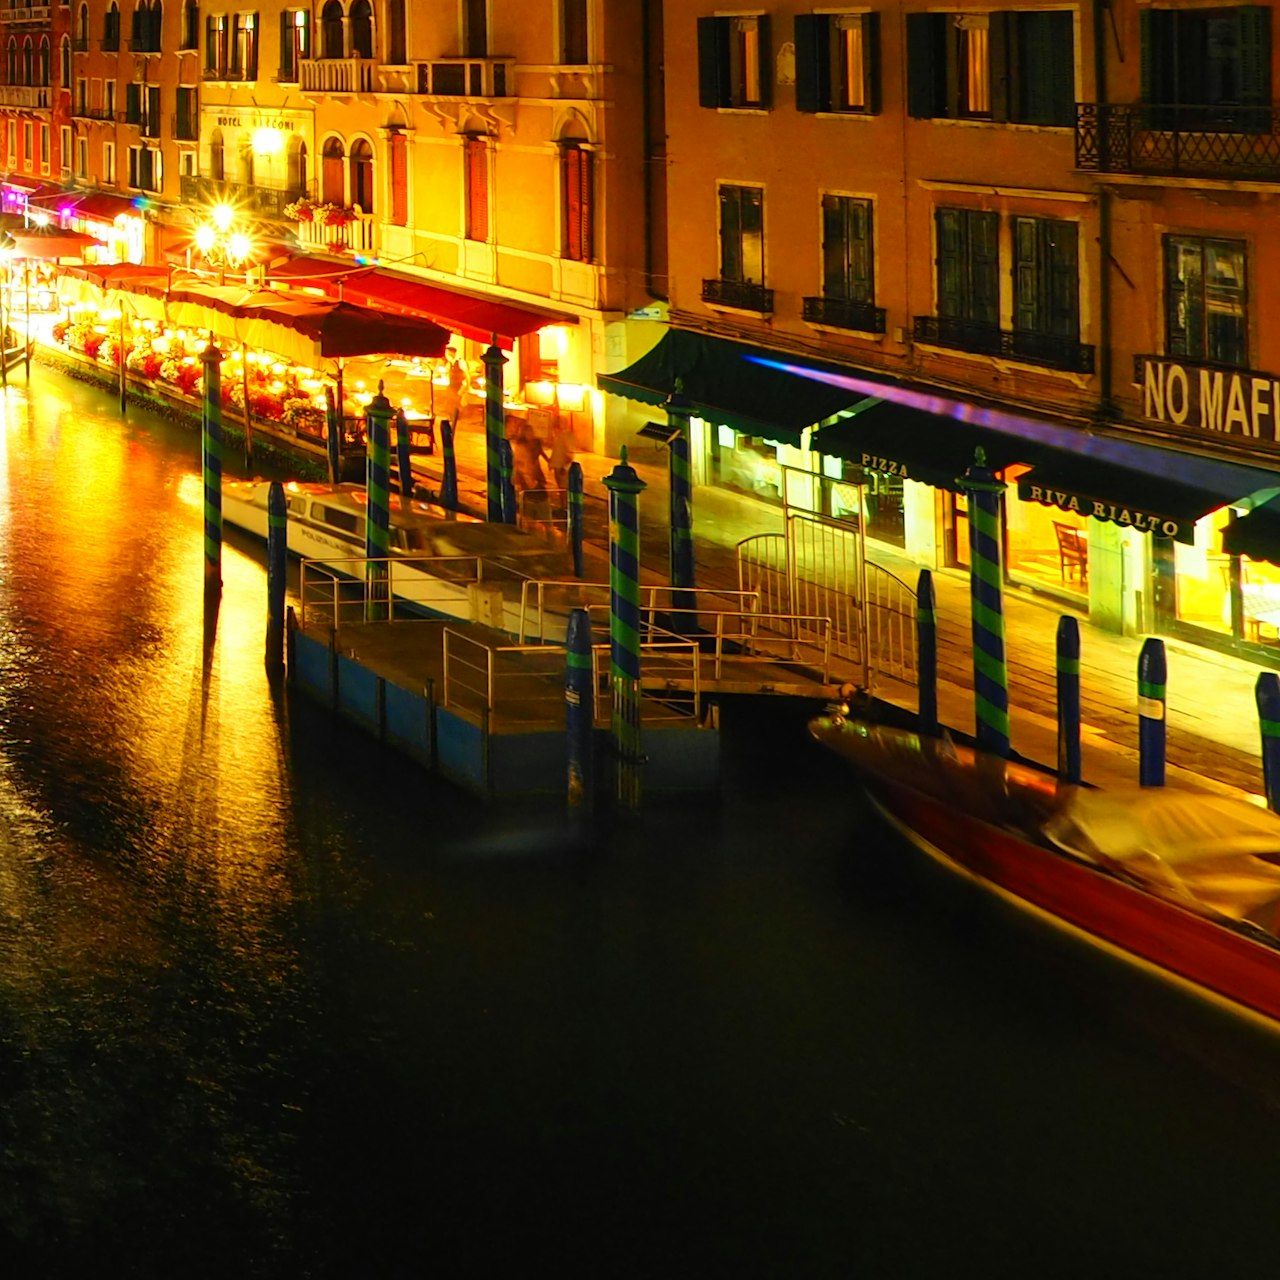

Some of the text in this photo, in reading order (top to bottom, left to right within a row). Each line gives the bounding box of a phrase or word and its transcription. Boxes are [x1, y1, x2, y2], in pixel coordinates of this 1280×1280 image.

[217, 116, 241, 127] HOTEL
[1145, 361, 1280, 442] NO MAFI
[861, 452, 909, 478] PIZZA
[1030, 485, 1179, 536] RIVA RIALTO
